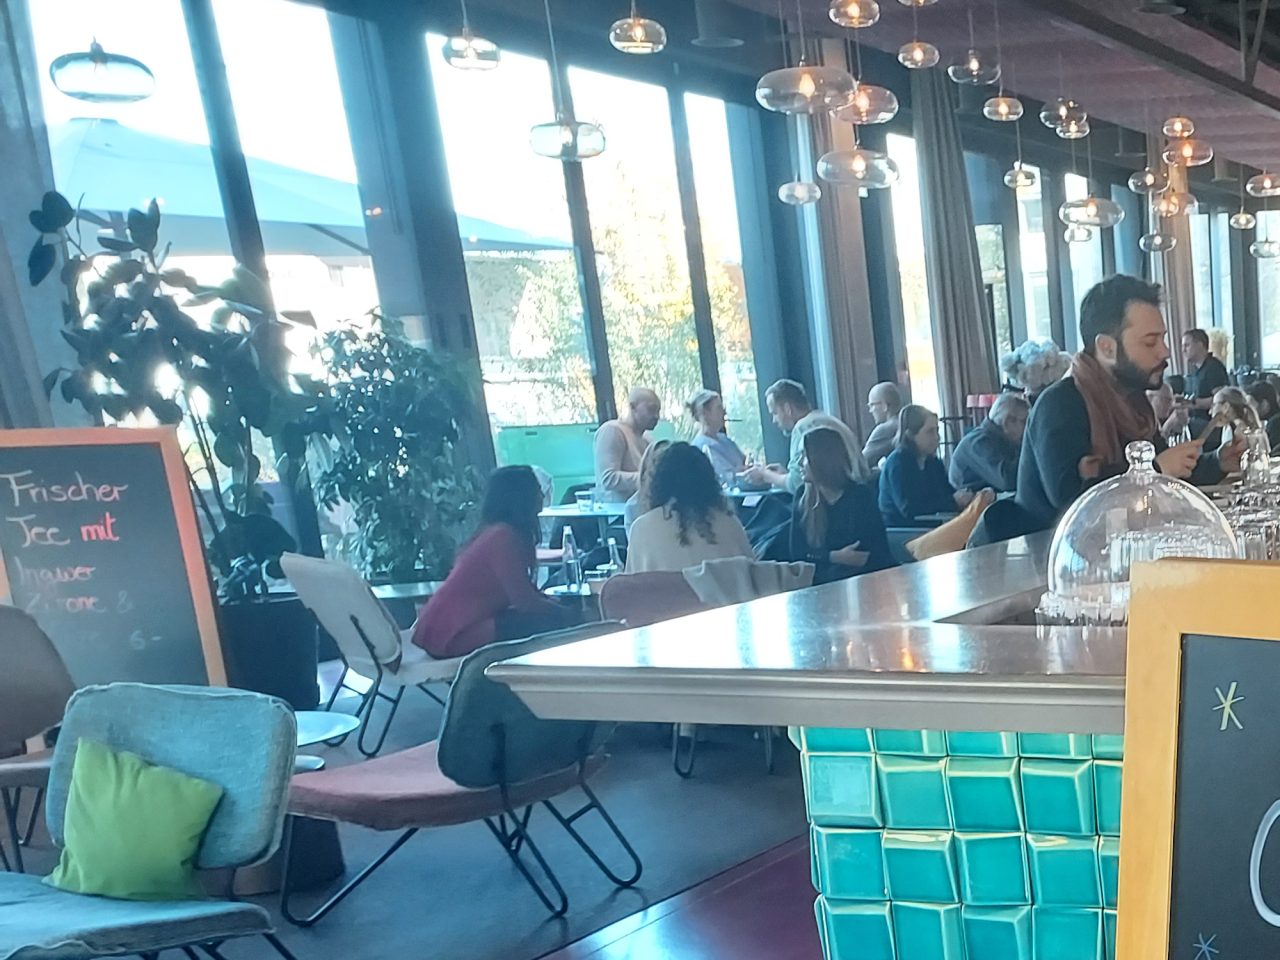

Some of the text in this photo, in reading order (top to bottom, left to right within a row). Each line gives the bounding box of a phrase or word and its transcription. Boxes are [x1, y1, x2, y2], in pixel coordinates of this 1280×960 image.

[0, 470, 128, 506] Frischer
[6, 511, 120, 549] Tee mit
